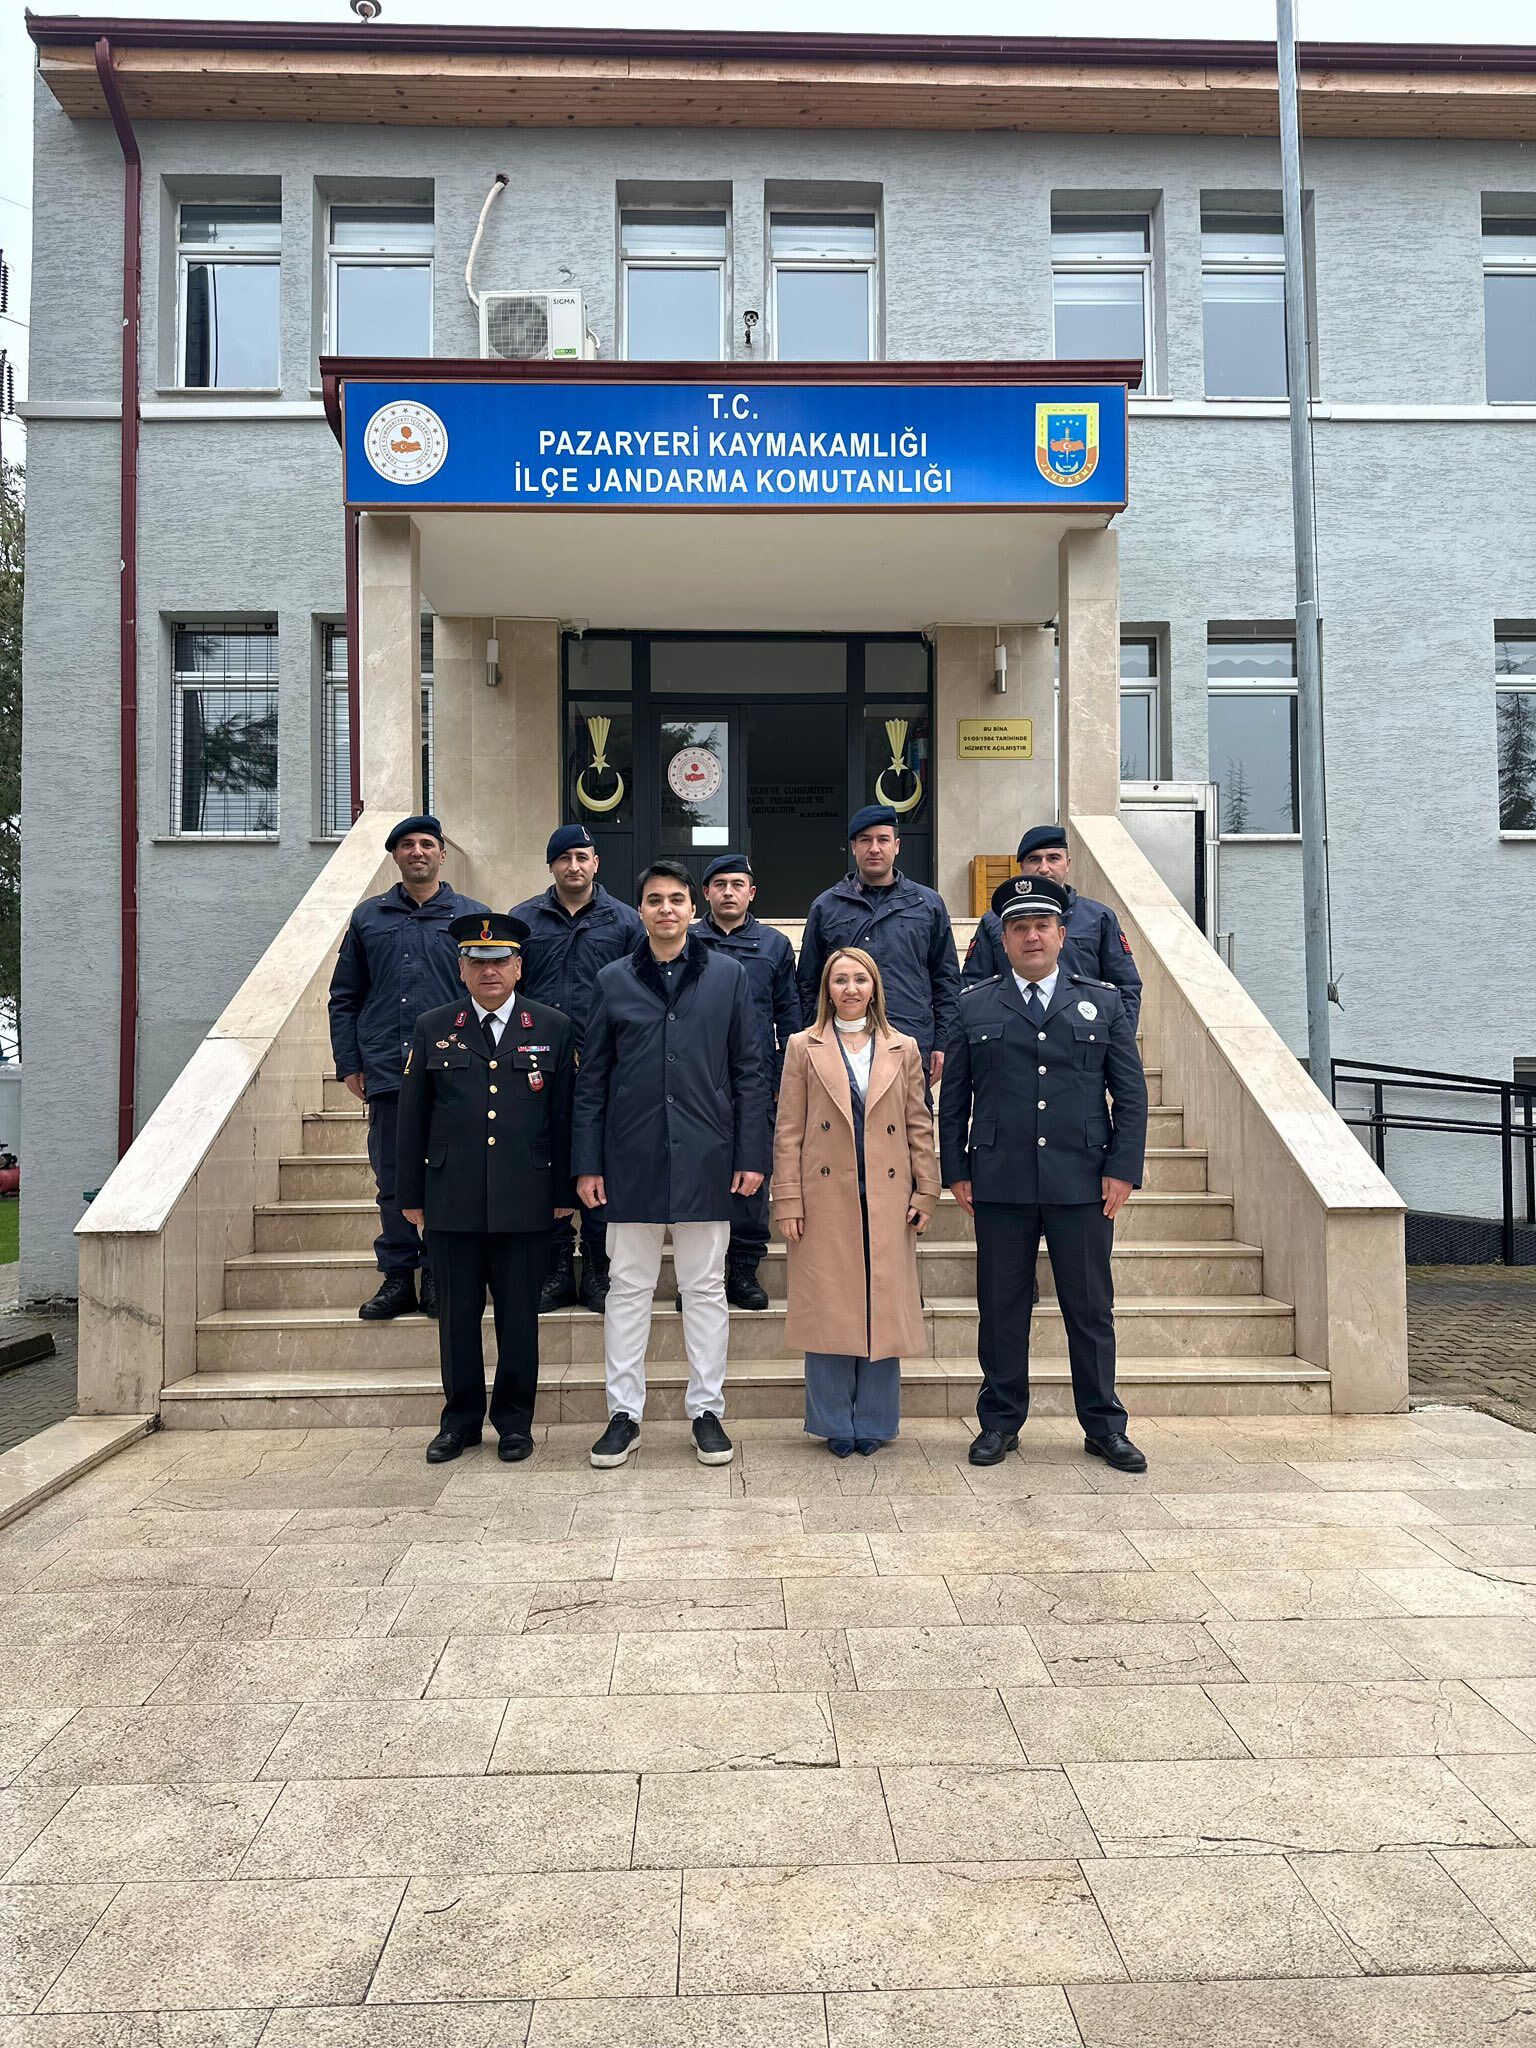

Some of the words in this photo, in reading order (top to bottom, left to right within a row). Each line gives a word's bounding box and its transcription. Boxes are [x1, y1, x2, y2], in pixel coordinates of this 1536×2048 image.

[707, 393, 758, 420] T.C.
[539, 425, 699, 456] PAZARYERİ
[709, 426, 927, 458] KAYMAKAMLIĞI
[515, 461, 579, 497] İLÇE
[587, 467, 749, 493] JANDARMA
[756, 463, 952, 493] KOMUTANLIĞI
[1041, 462, 1093, 483] JANDARMA
